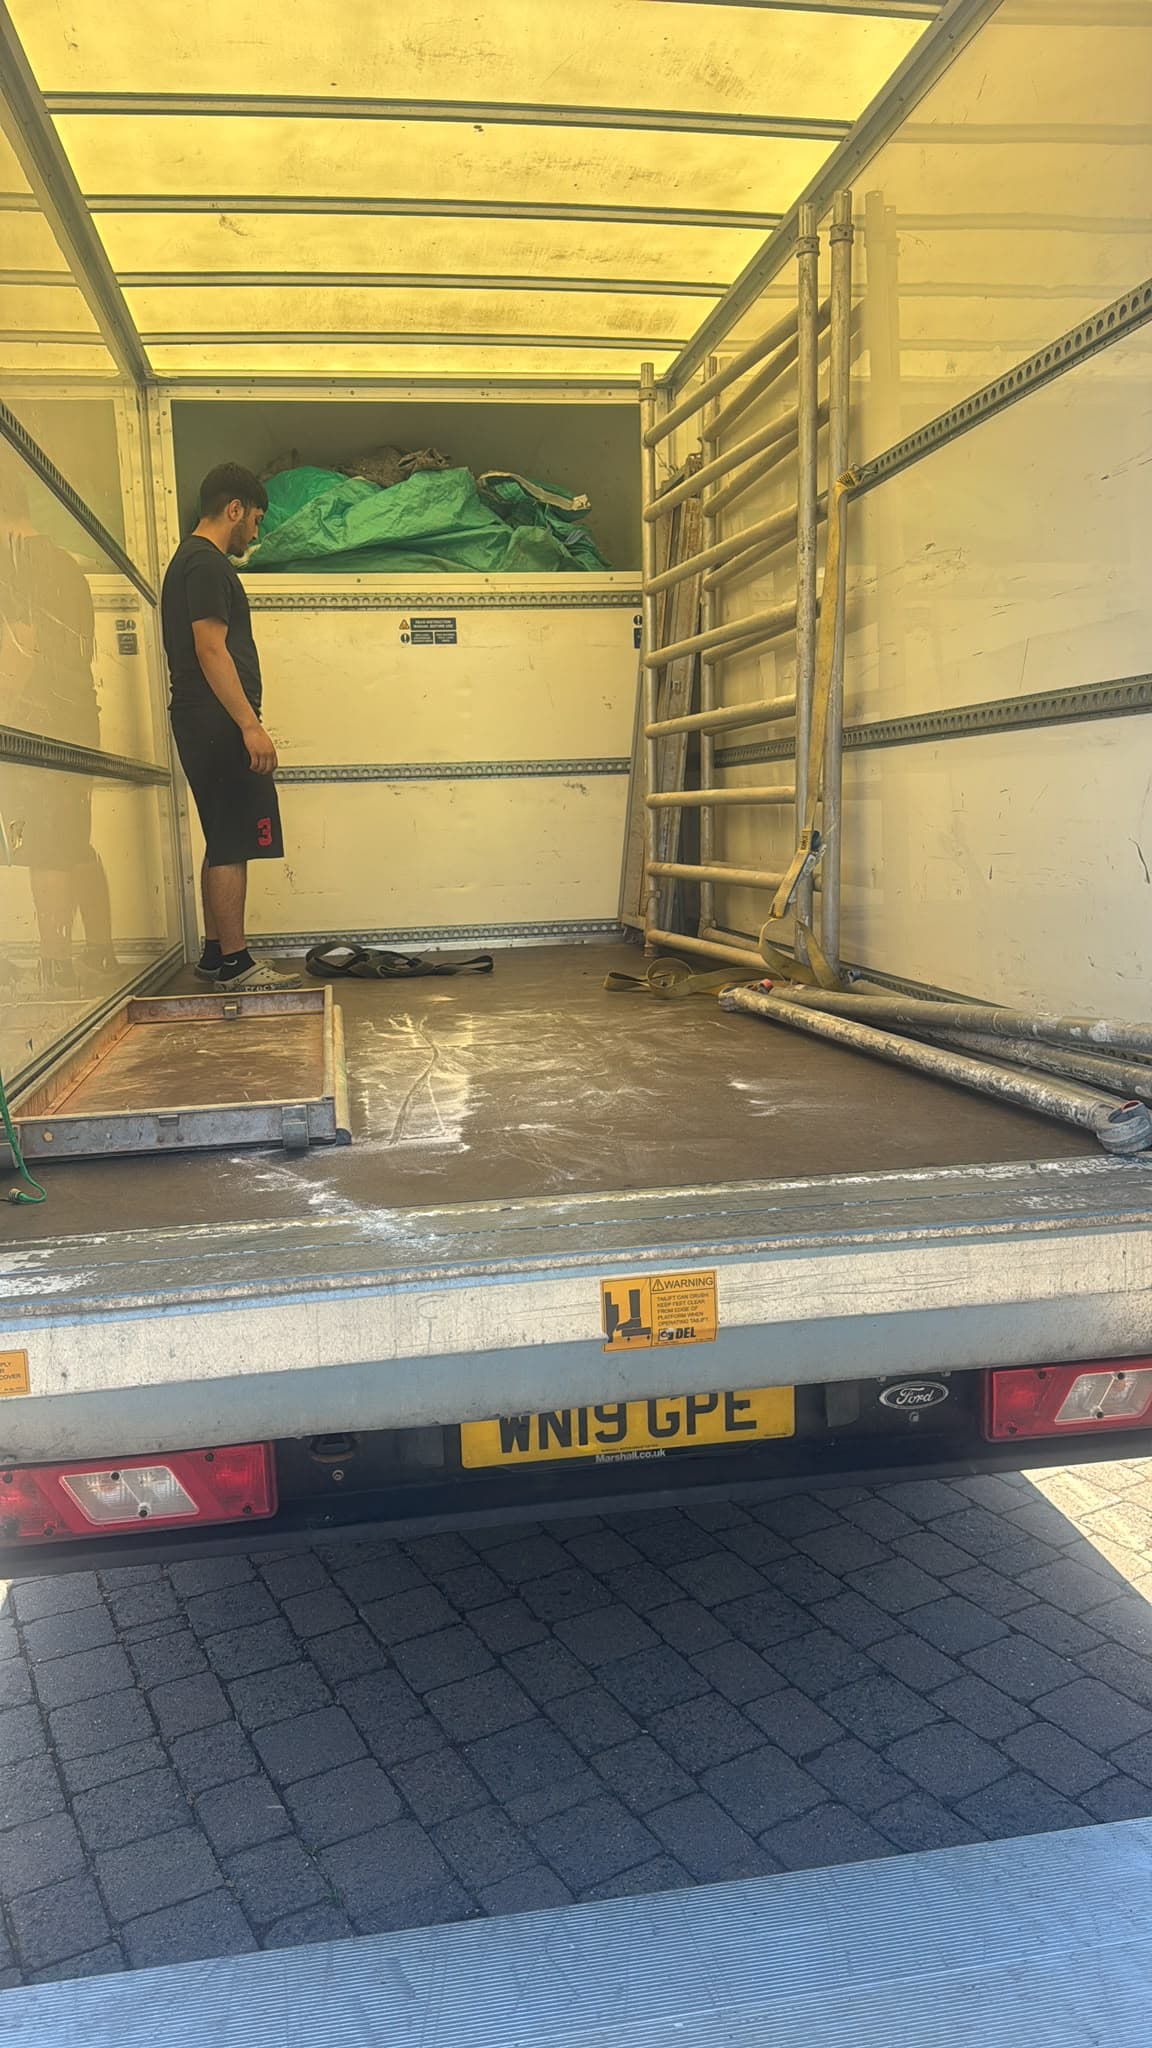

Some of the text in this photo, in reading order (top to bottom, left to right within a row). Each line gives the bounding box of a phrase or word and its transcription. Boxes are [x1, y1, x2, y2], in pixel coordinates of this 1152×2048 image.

[257, 818, 272, 847] 3
[664, 1277, 713, 1288] WARNING
[675, 1327, 696, 1339] DEL
[896, 1387, 934, 1405] Ford
[500, 1391, 757, 1454] WN19 GPE
[595, 1449, 666, 1464] Marshall.co.uk
